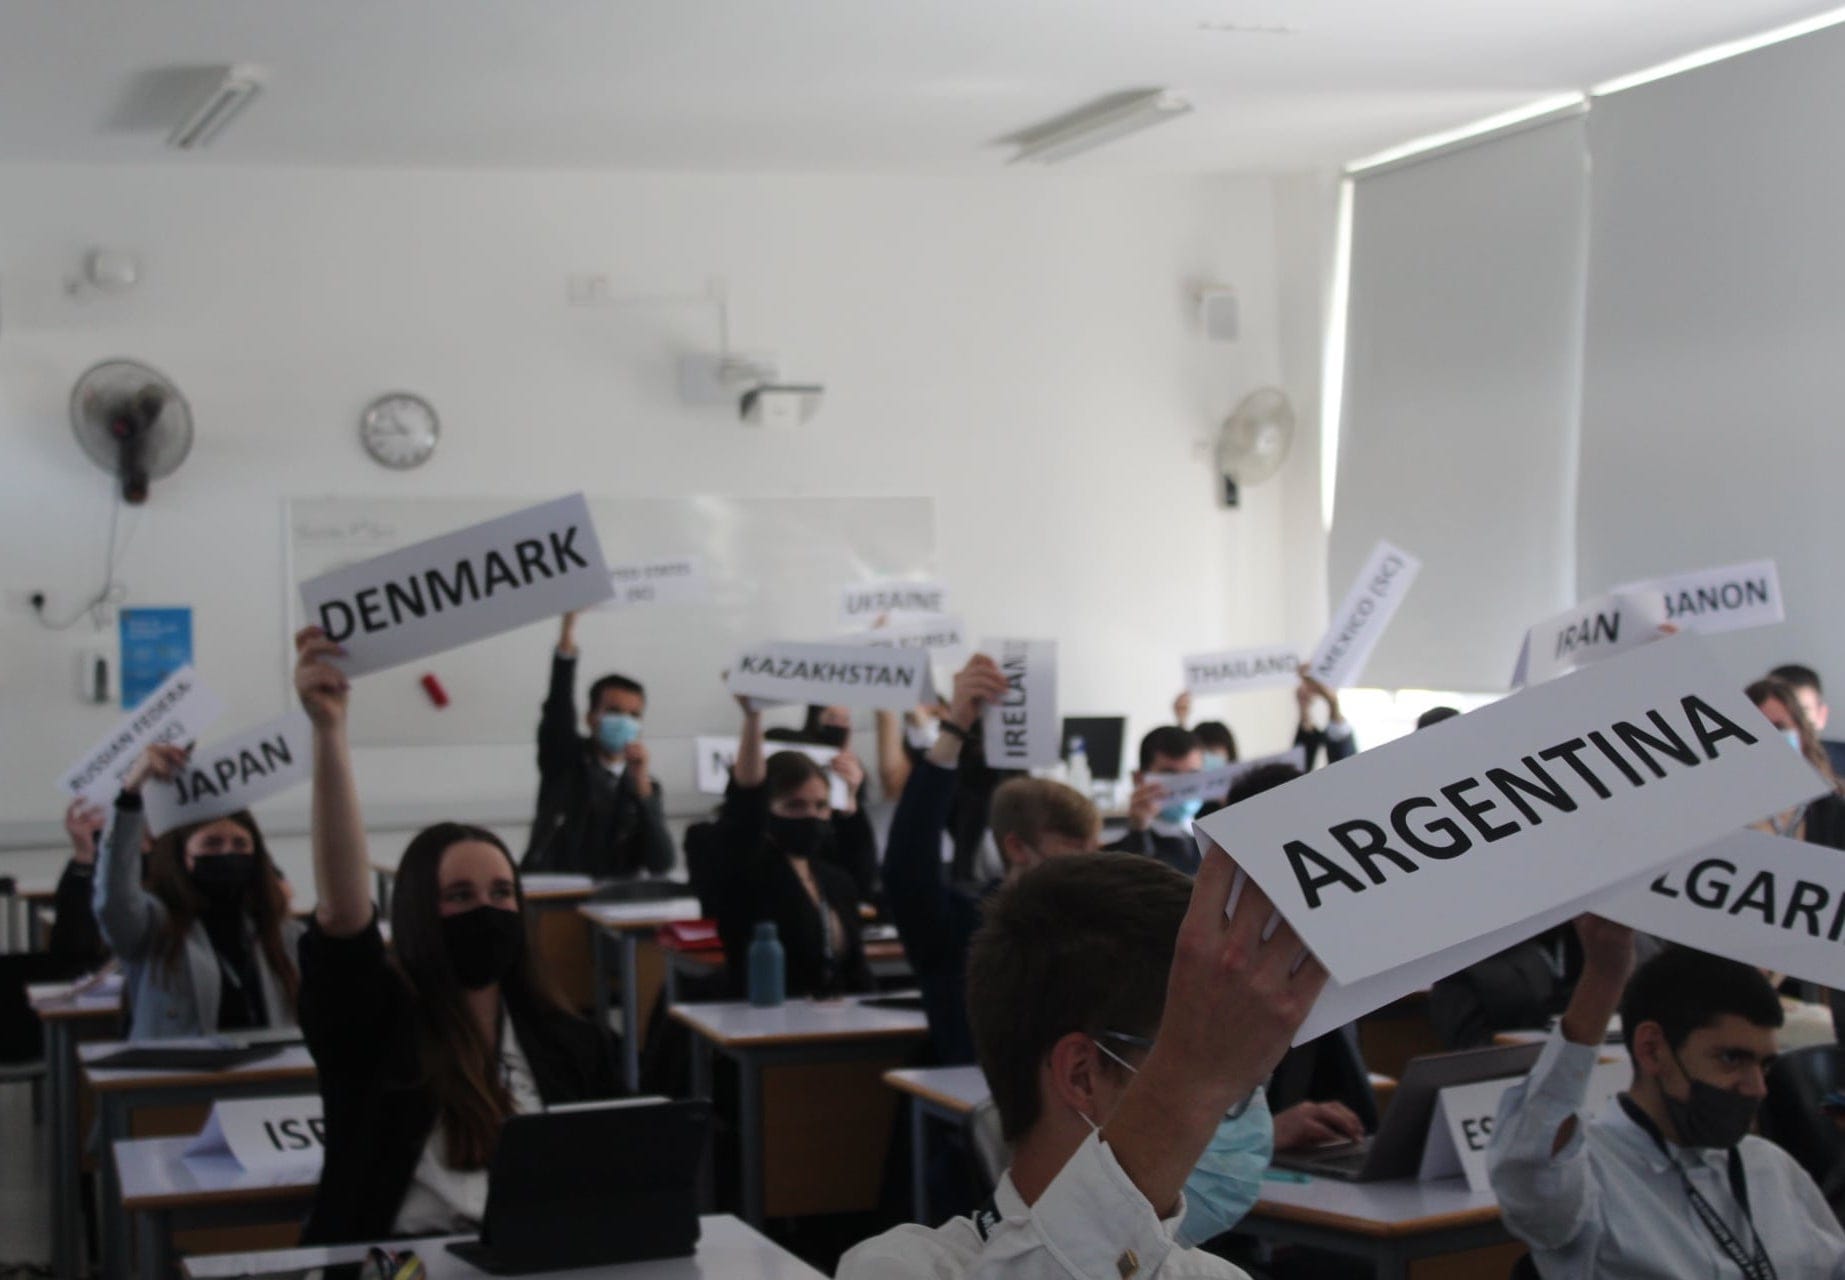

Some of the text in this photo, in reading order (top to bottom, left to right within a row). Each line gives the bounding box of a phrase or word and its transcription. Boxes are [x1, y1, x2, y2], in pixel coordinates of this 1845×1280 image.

[319, 525, 588, 644] DENMARK
[846, 590, 943, 615] UKRAINE
[1317, 555, 1406, 678] MEXICO (SC)
[1555, 610, 1621, 660] IRAN
[740, 655, 915, 689] KAZAKHSTAN
[1189, 653, 1301, 684] THAILAND
[69, 731, 136, 791] RUSSIAN
[175, 733, 293, 806] JAPAN
[1283, 695, 1759, 909] ARGENTINA
